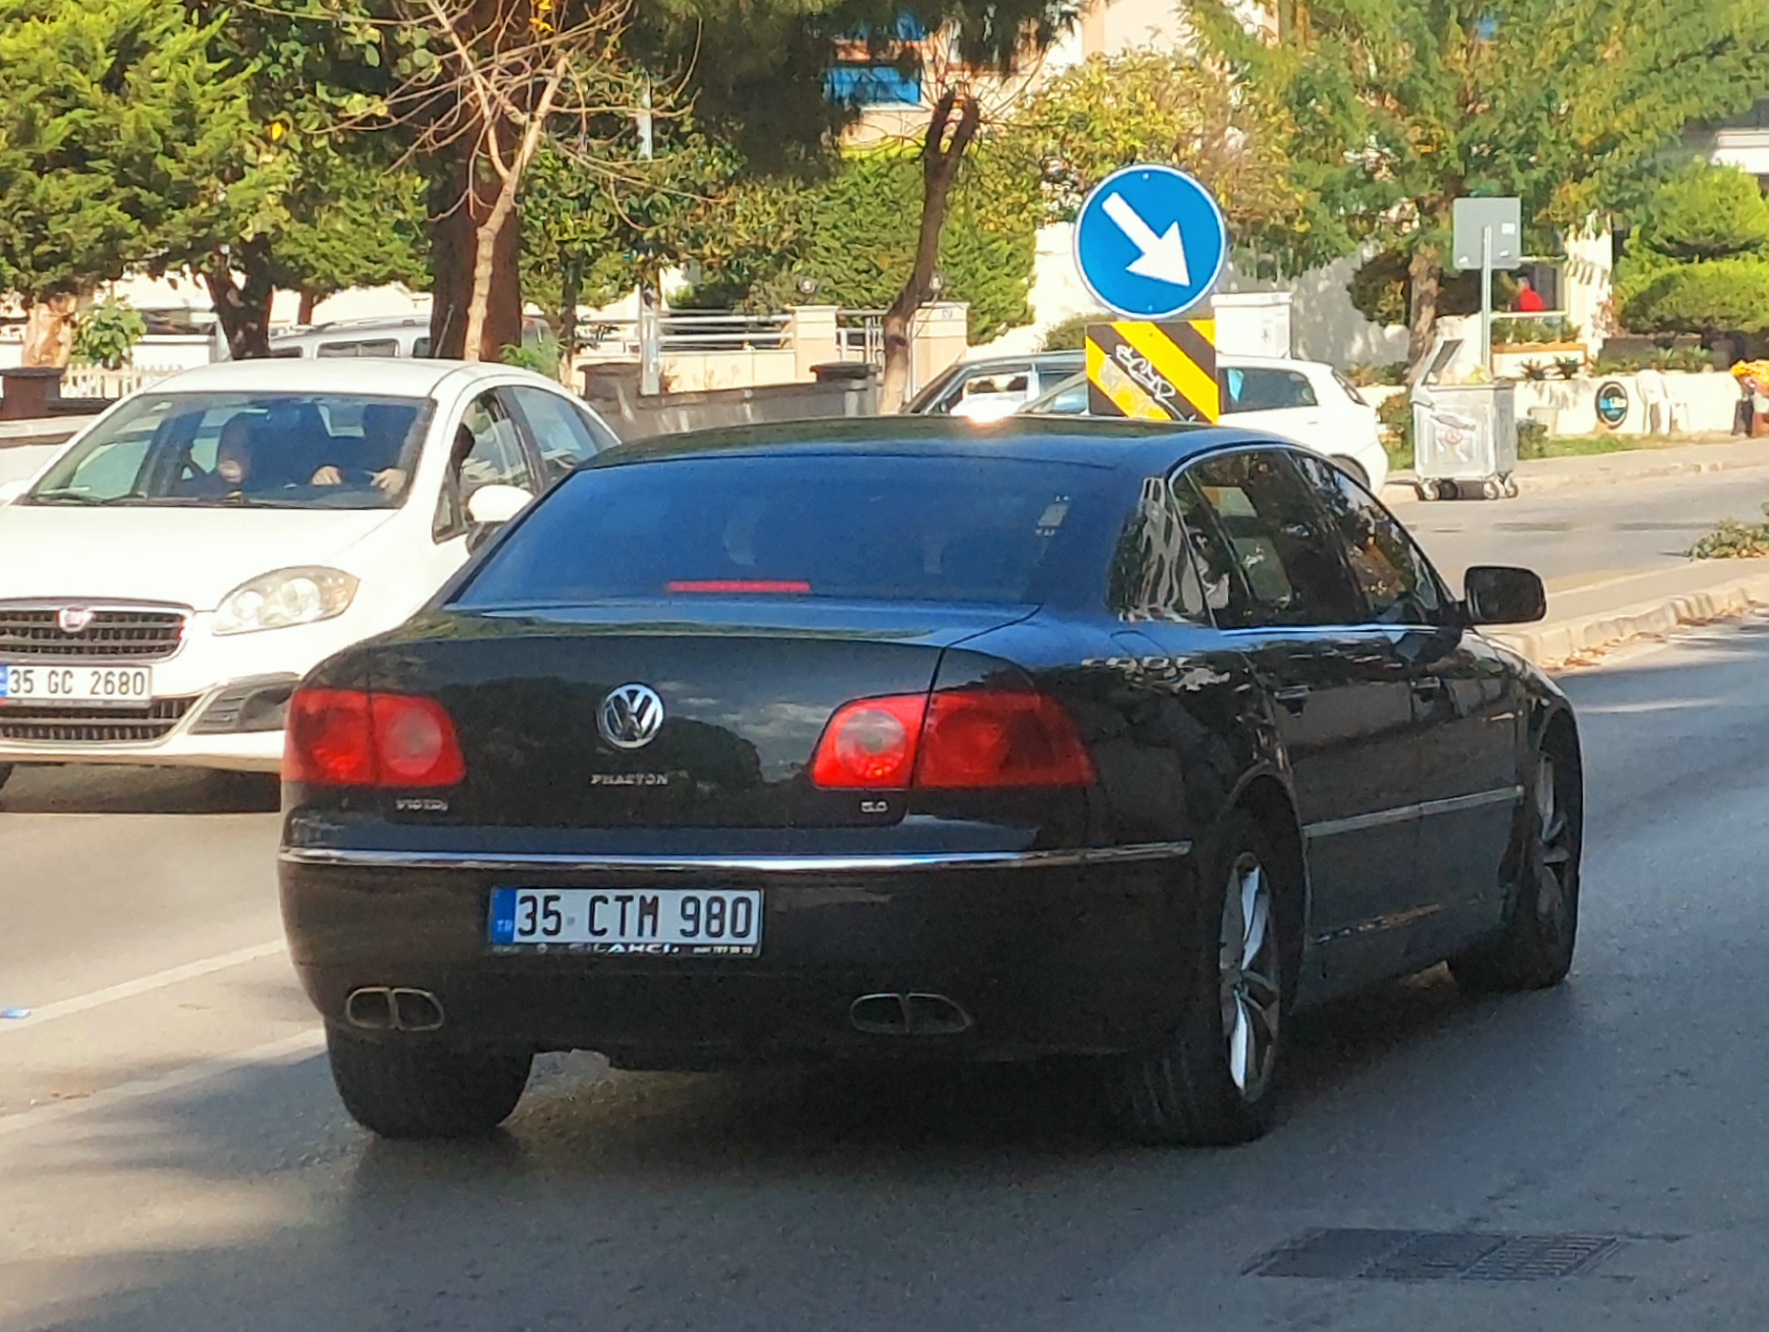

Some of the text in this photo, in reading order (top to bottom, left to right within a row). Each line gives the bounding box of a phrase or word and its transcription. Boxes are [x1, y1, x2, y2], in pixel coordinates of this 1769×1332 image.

[10, 669, 145, 695] 35 GC 2680
[518, 895, 562, 936] 35
[588, 895, 660, 937] CTM
[680, 896, 753, 938] 980
